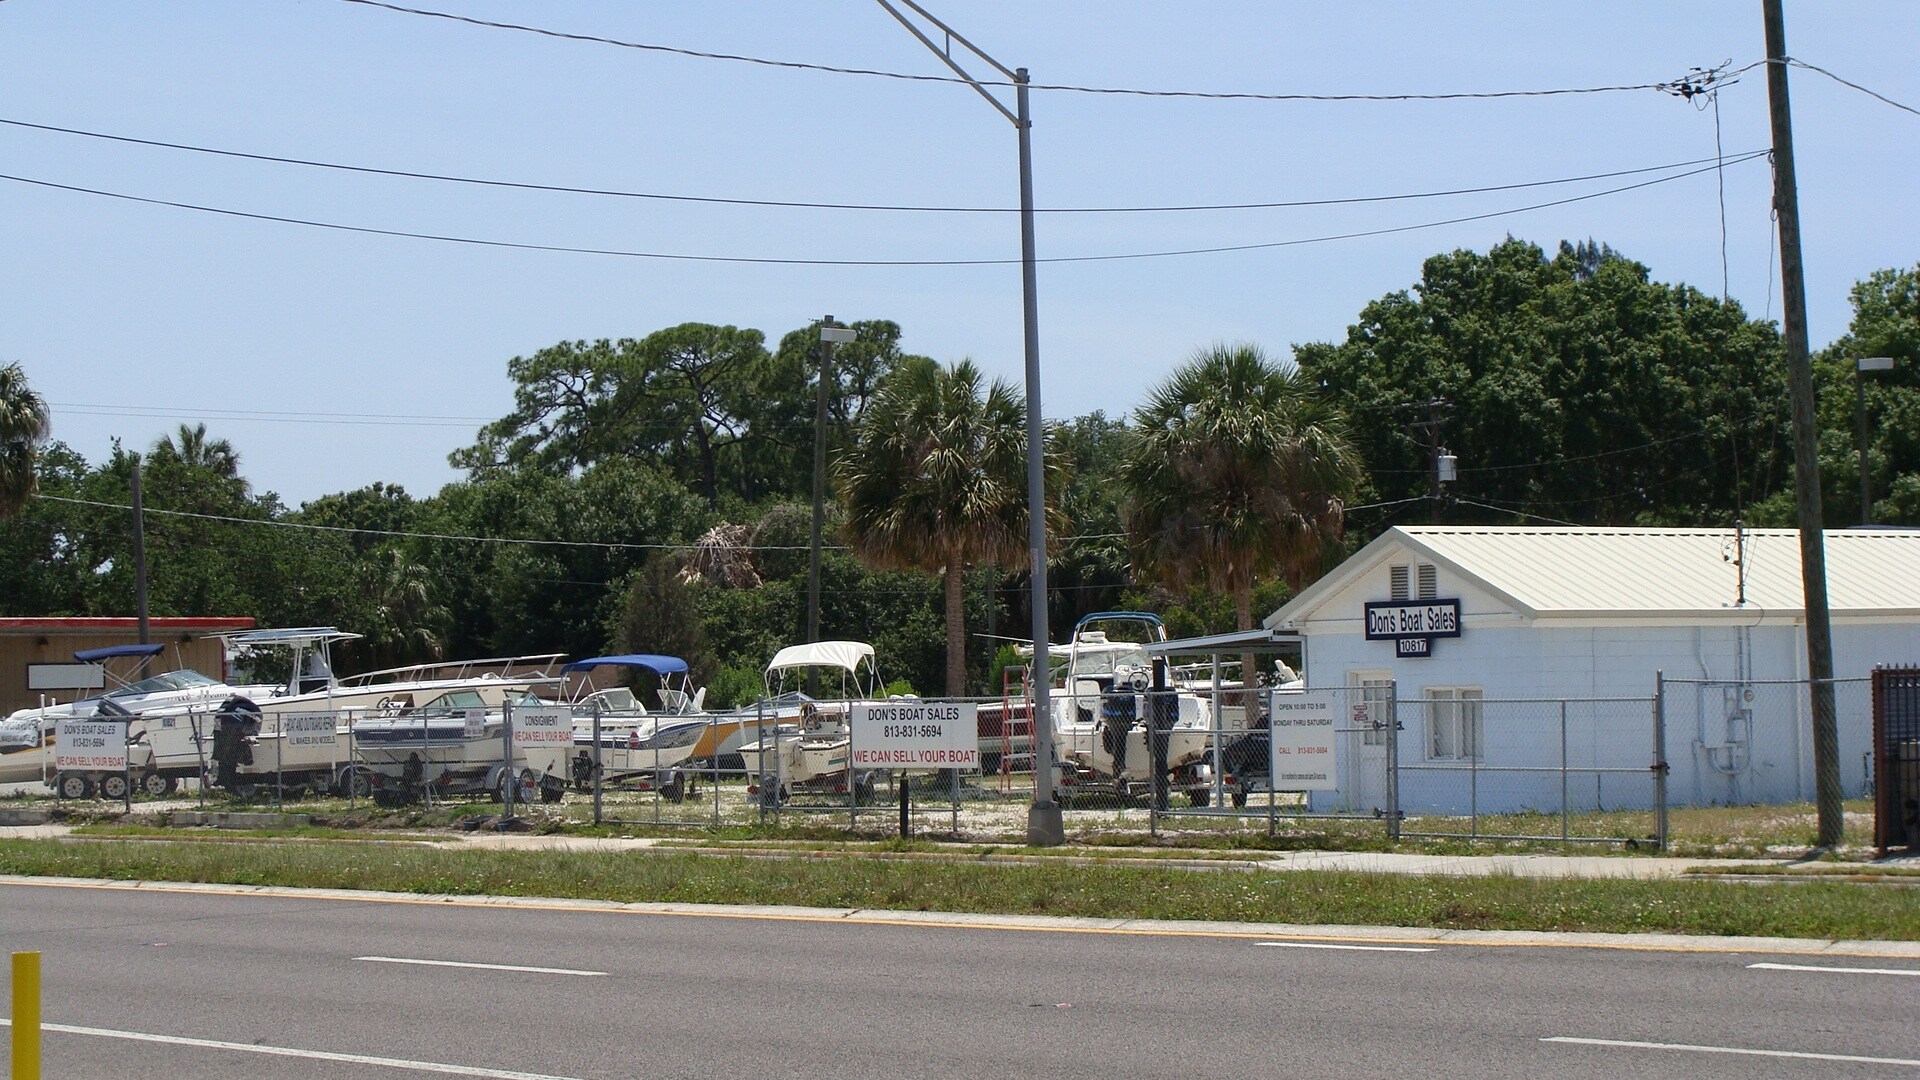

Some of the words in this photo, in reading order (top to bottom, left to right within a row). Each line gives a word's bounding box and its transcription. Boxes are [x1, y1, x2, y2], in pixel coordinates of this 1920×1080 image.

[1369, 610, 1396, 633] Don's
[1400, 608, 1423, 632] Boat
[1427, 606, 1455, 631] Sales
[1401, 639, 1427, 652] 10817
[868, 707, 897, 721] DON'S
[899, 708, 925, 720] BOAT
[927, 707, 960, 720] SALES
[525, 715, 558, 726] CONSIGNMENT
[1273, 719, 1293, 727] MONDAY
[1293, 719, 1306, 727] THRU
[1306, 719, 1333, 727] SATURDAY
[81, 725, 97, 734] BOAT
[97, 725, 116, 734] SALES
[884, 725, 942, 738] 813-831-5694
[515, 731, 522, 742] WE
[522, 731, 532, 742] CAN
[532, 731, 545, 742] SELL
[545, 731, 558, 742] YOUR
[558, 731, 572, 742] BOAT
[854, 750, 868, 763] WE
[870, 750, 891, 763] CAN
[893, 750, 917, 763] SELL
[918, 750, 946, 763] YOUR
[948, 749, 976, 763] BOAT
[1279, 747, 1291, 755] CALL
[65, 756, 78, 766] CAN
[78, 756, 91, 766] SELL
[92, 756, 109, 766] YOUR
[109, 757, 125, 767] BOAT
